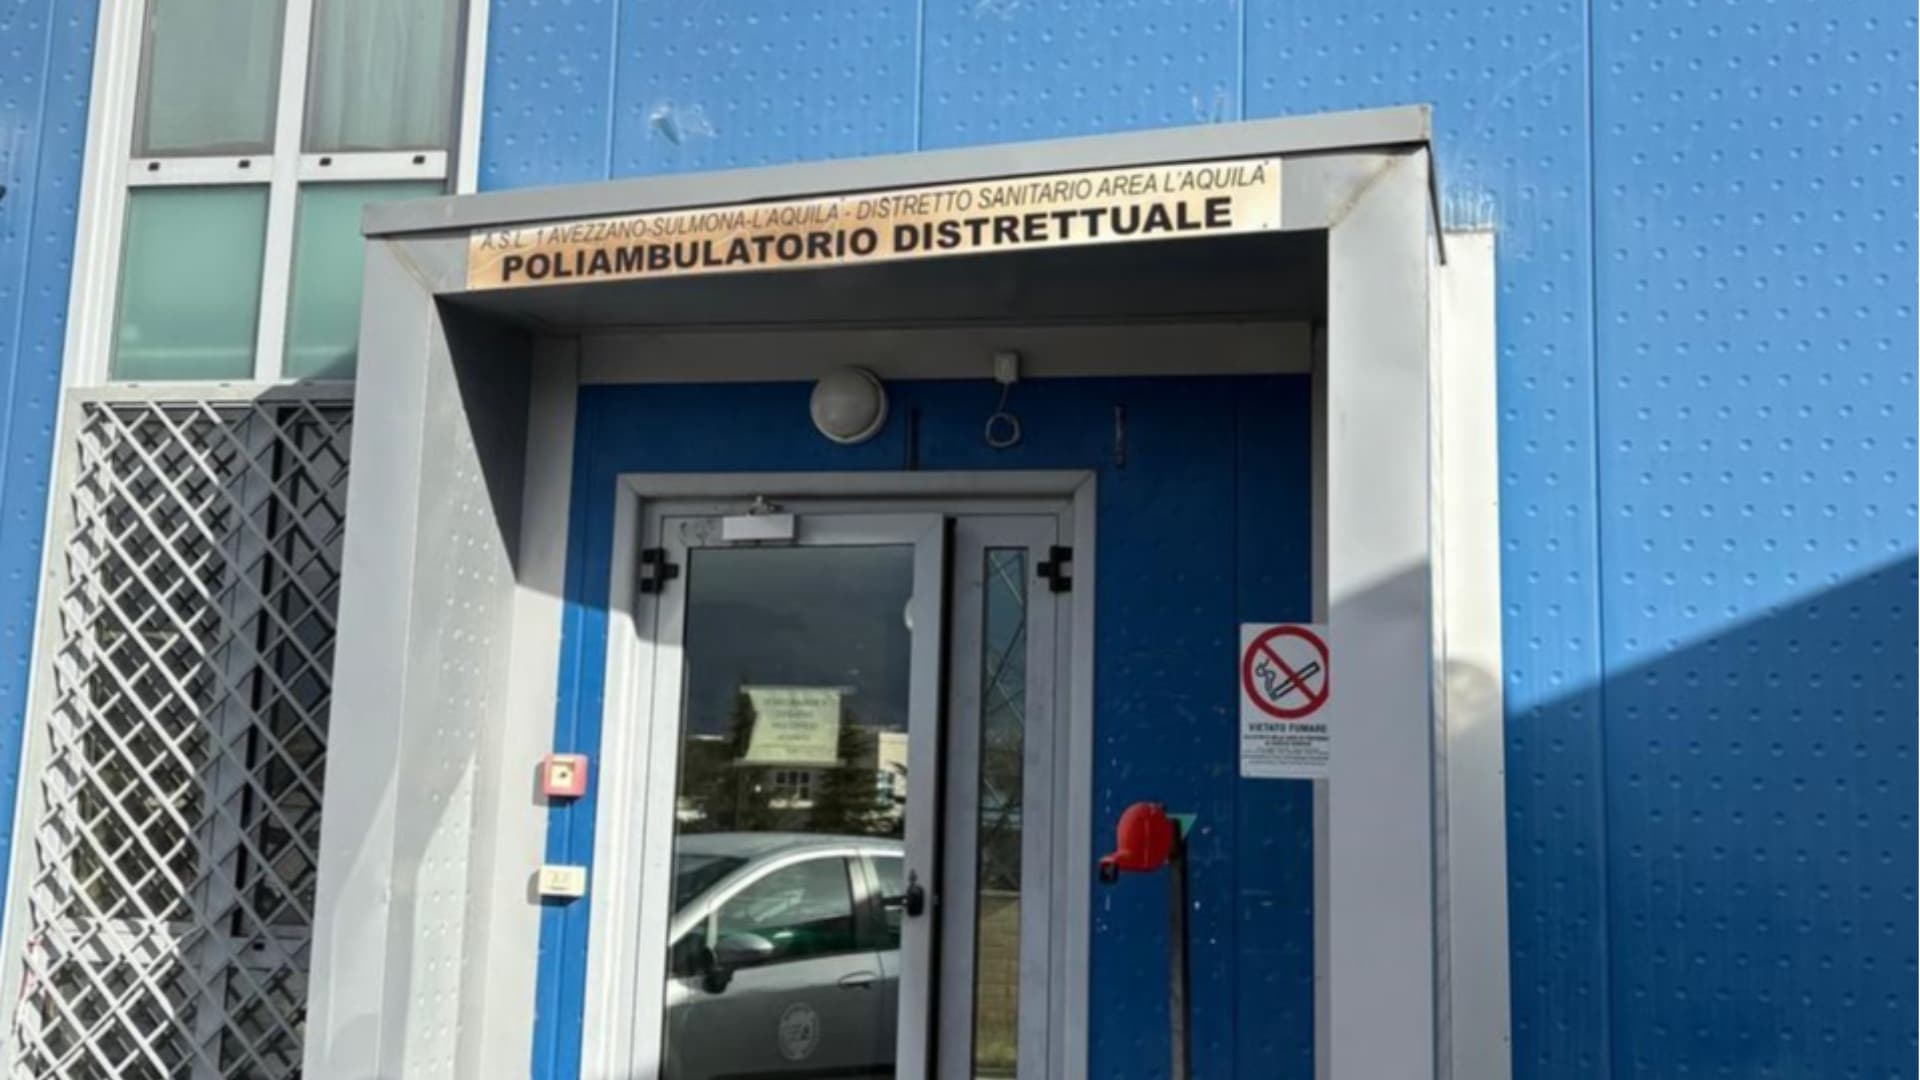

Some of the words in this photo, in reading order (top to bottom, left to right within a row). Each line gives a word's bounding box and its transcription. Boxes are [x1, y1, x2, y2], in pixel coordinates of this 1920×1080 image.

[857, 189, 972, 219] DISTRETTO
[978, 176, 1091, 208] SANITARIO
[1096, 172, 1158, 198] AREA
[1164, 164, 1266, 191] L'AQUILA
[502, 227, 878, 282] POLIAMBULATORIO
[894, 196, 1233, 253] DISTRETTUALE
[1248, 722, 1286, 732] VIETATO
[1288, 723, 1327, 733] FUMARE
